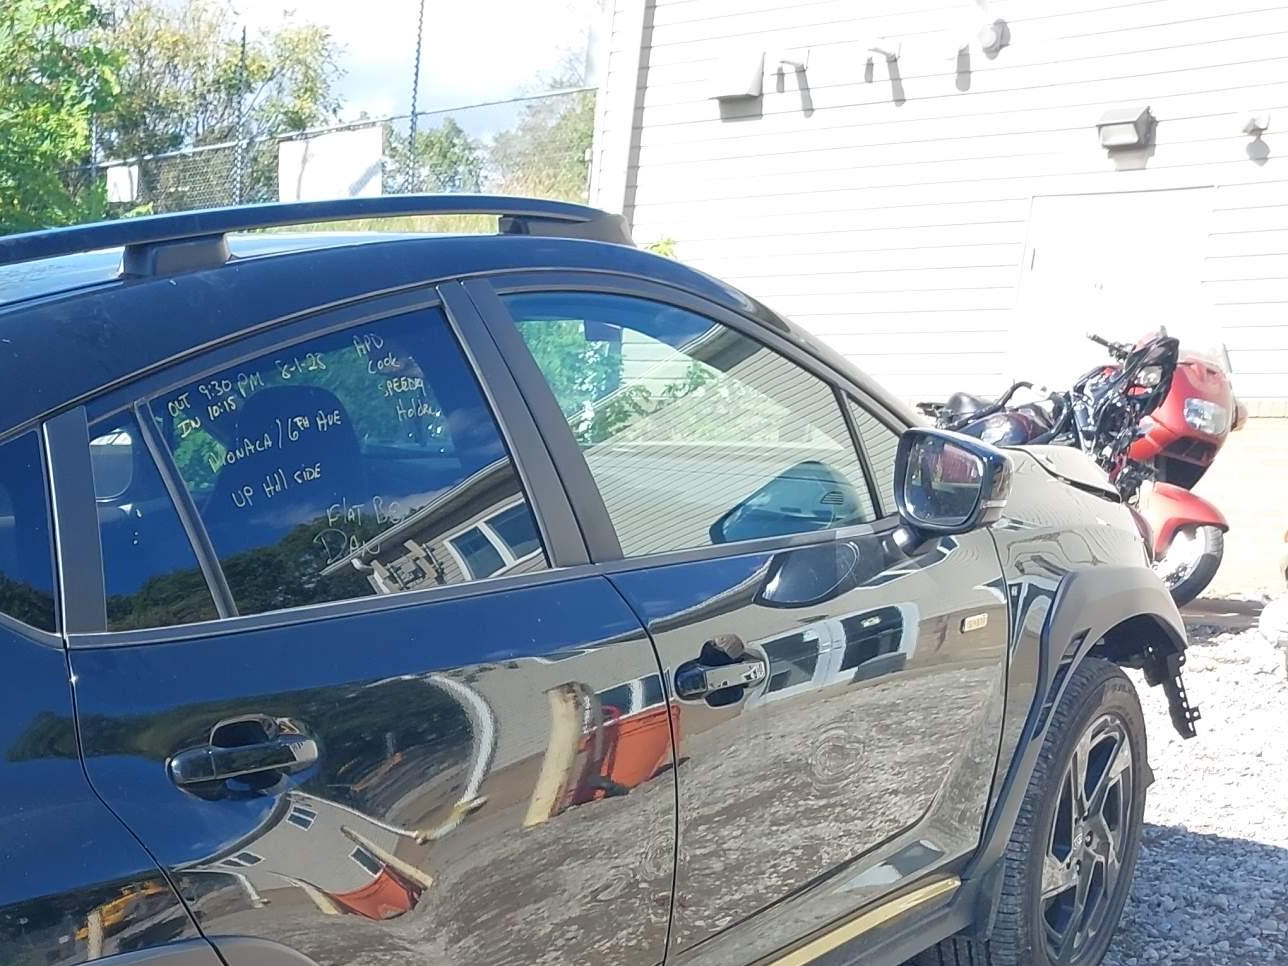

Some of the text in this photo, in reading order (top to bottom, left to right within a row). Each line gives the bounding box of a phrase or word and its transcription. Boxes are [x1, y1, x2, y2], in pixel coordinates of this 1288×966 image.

[168, 393, 190, 417] OUT
[199, 379, 232, 400] 9:30
[238, 372, 265, 397] PM
[177, 396, 236, 438] IN 10:15
[316, 410, 342, 432] AVE
[231, 485, 254, 508] UP
[294, 463, 321, 484] SIDE
